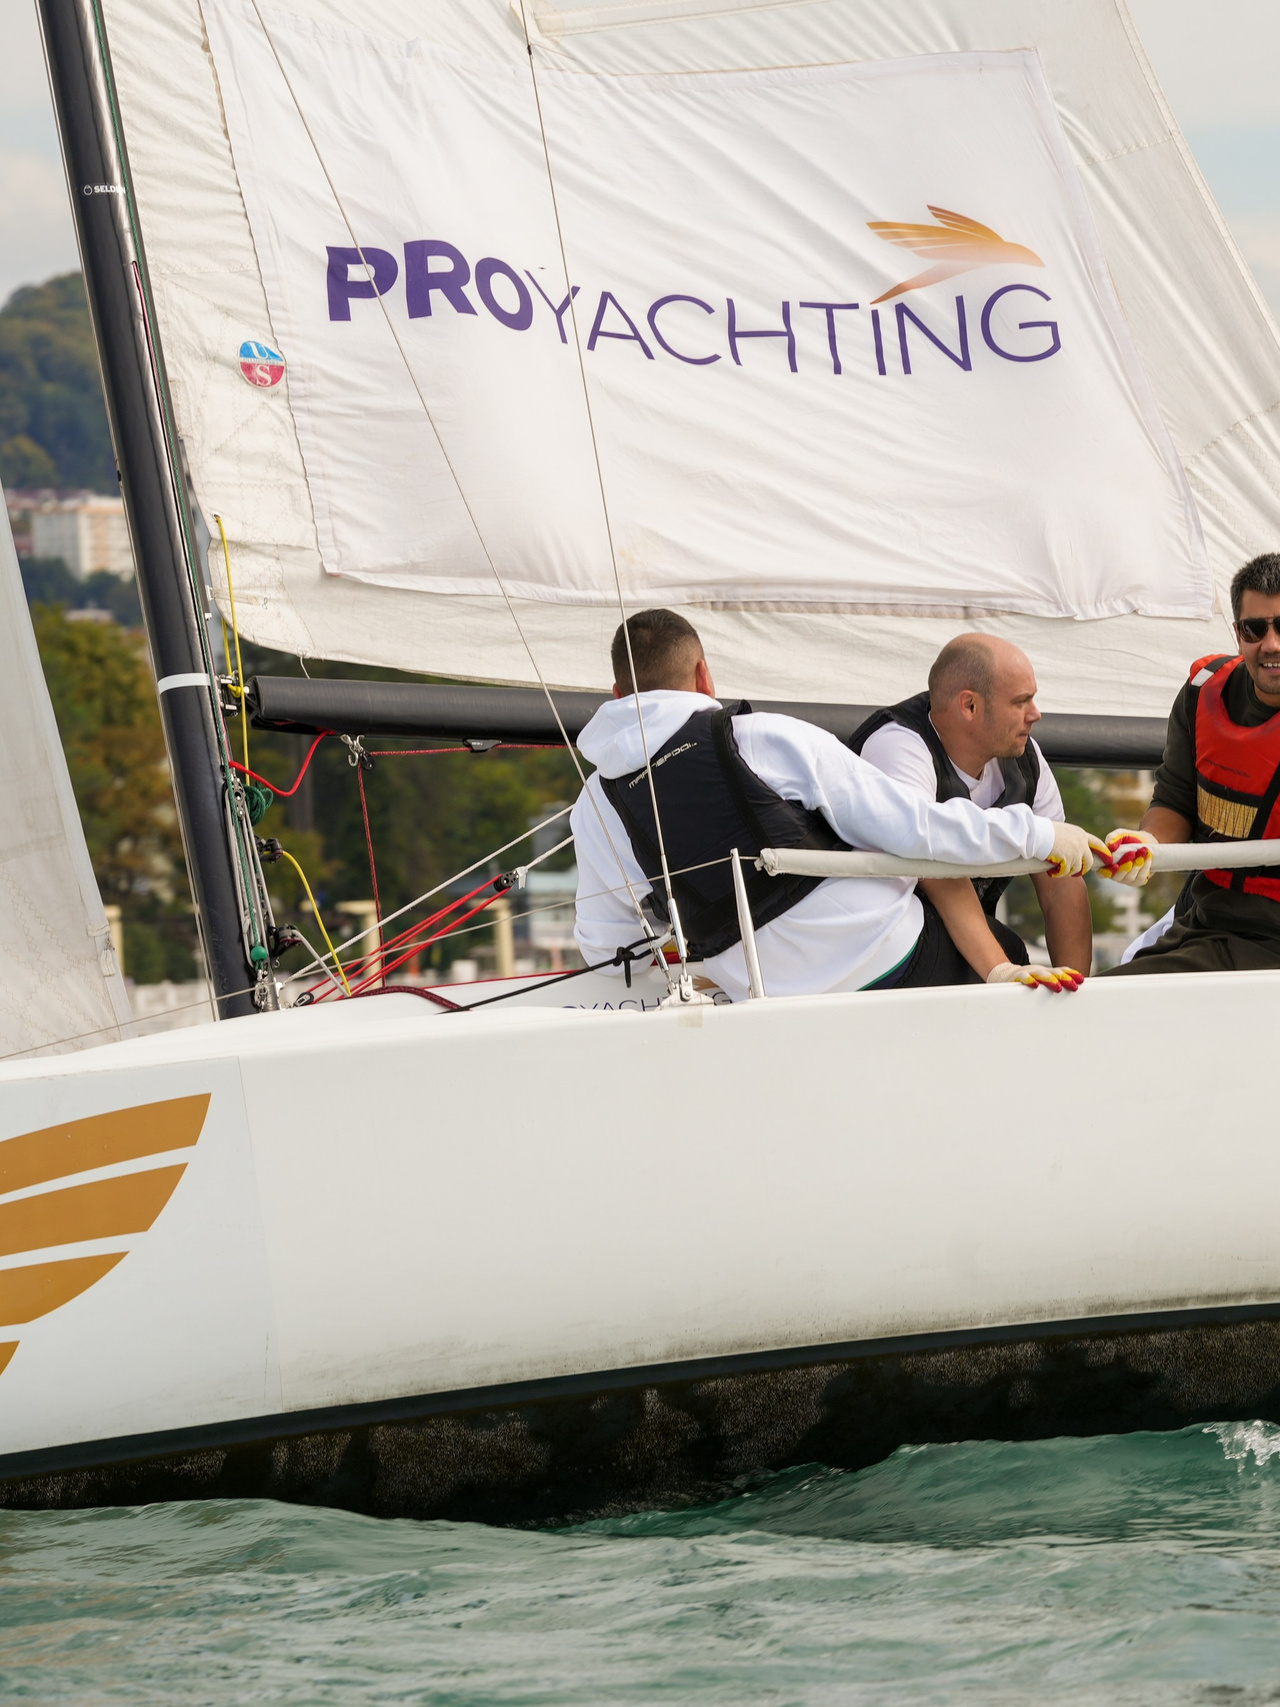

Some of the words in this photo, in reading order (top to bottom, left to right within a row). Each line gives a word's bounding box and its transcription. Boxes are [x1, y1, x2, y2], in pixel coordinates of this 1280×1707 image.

[325, 239, 1062, 375] PROYACHTING
[256, 363, 272, 386] S
[628, 742, 698, 789] MARNEPOOL
